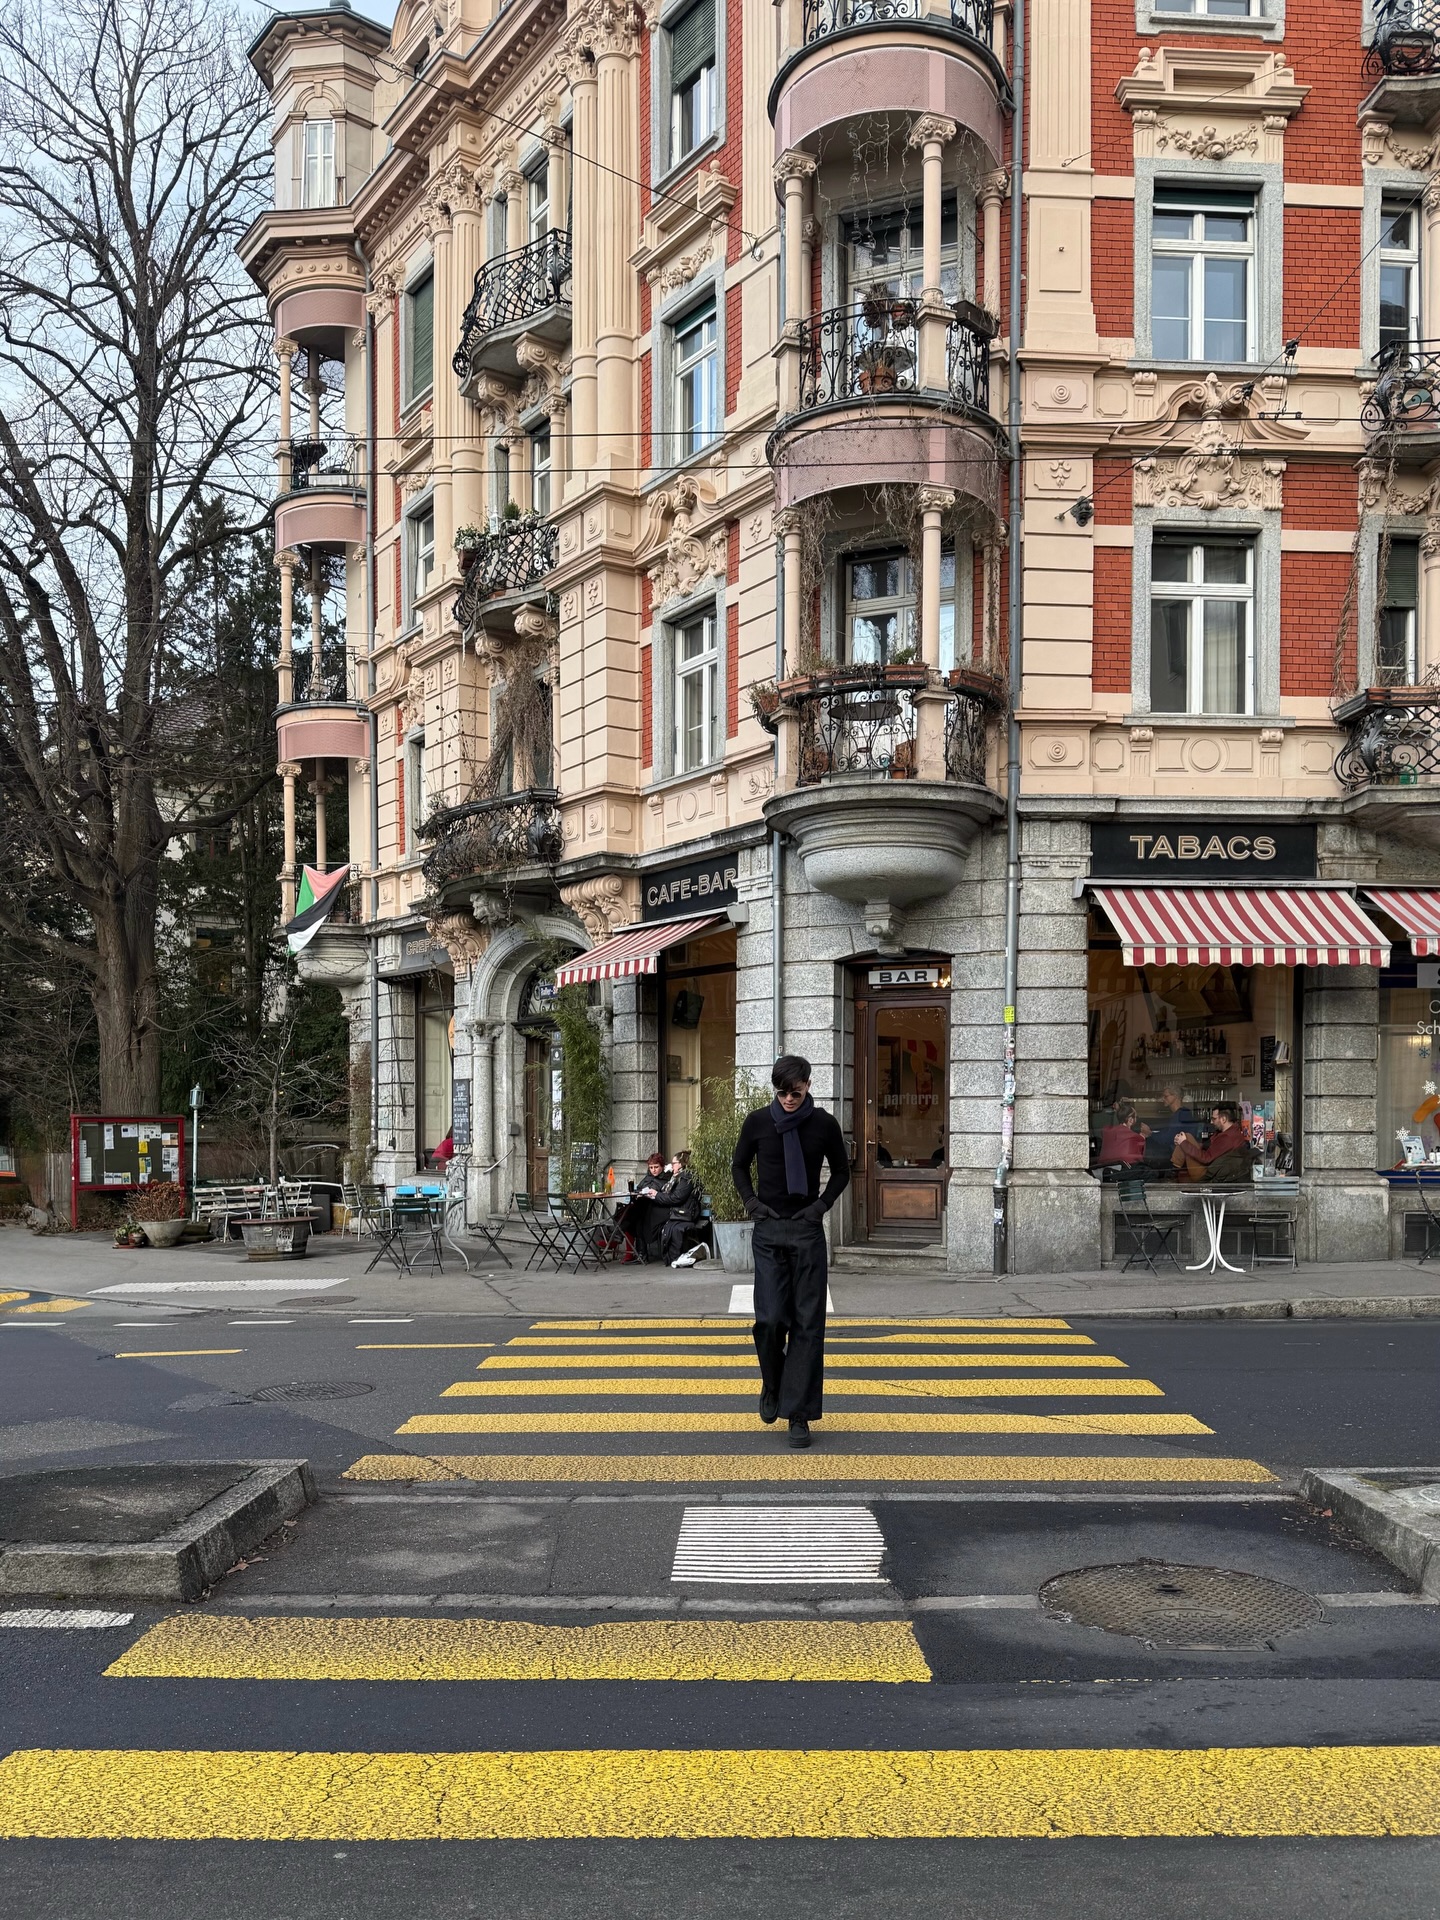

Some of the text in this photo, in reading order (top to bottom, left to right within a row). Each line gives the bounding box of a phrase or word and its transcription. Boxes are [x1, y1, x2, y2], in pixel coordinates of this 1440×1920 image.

[1129, 835, 1277, 861] TABACS
[646, 867, 738, 907] CAFE-BAR
[879, 970, 928, 983] BAR
[884, 1092, 939, 1110] parterre
